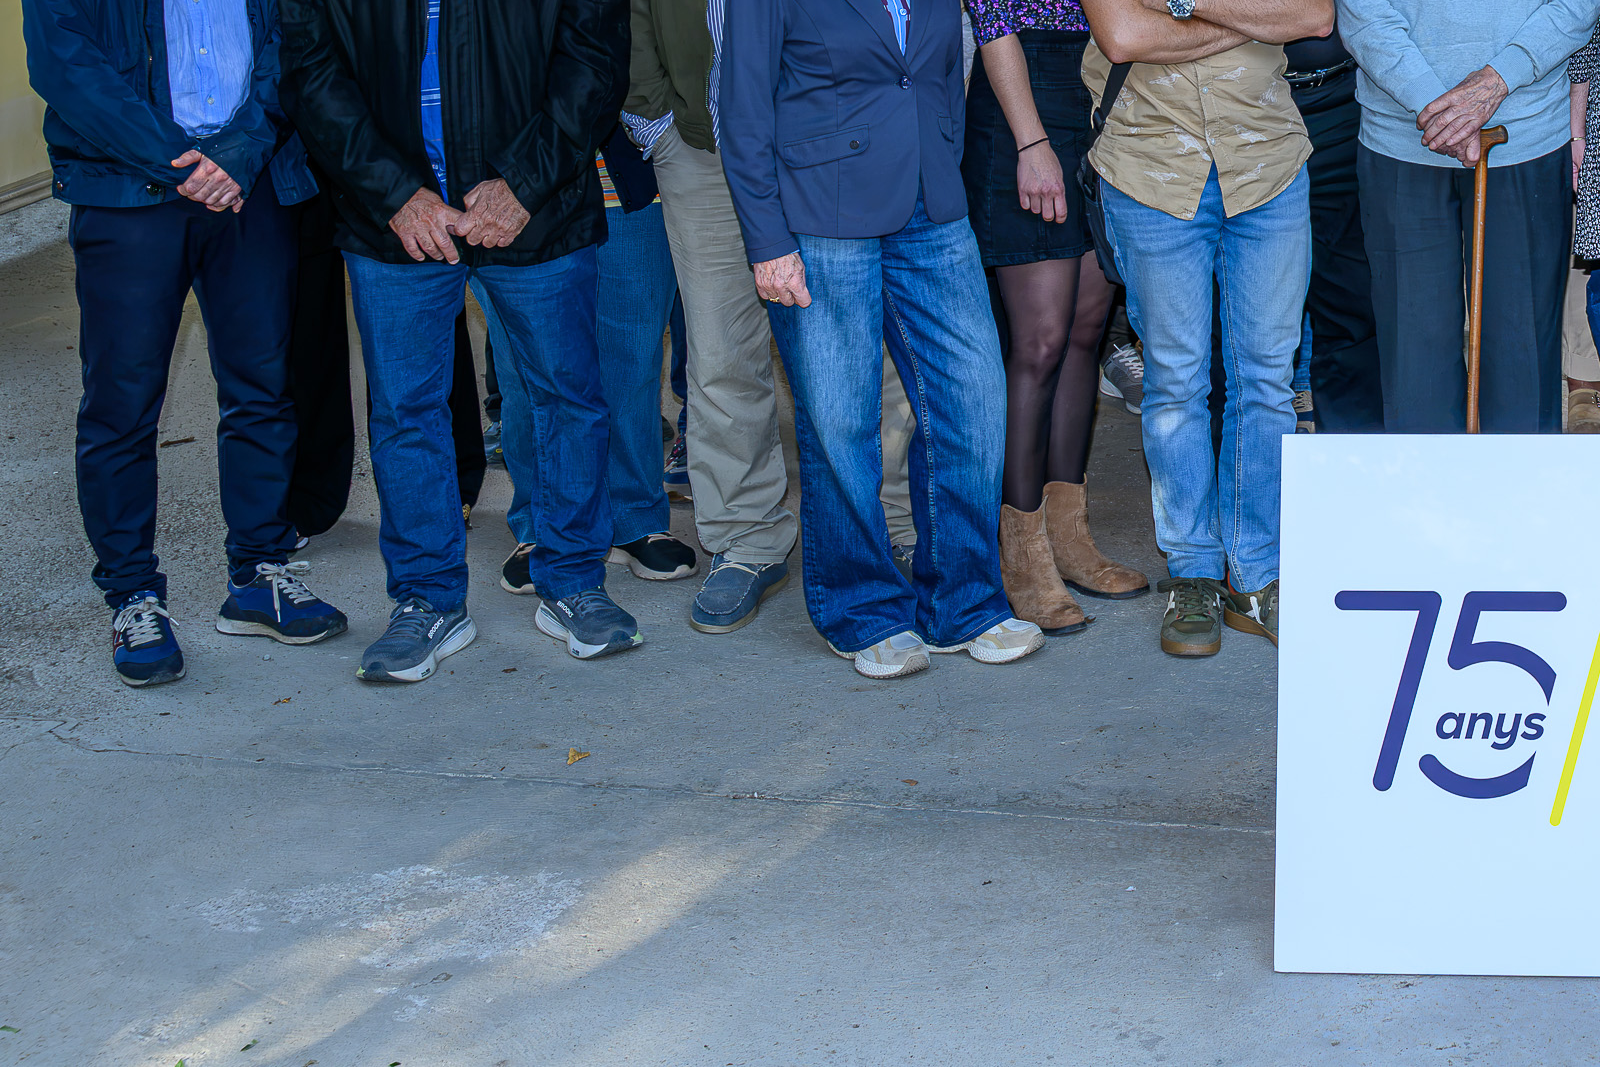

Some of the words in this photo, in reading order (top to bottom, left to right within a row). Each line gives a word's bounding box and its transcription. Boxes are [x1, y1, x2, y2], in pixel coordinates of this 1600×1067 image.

[556, 600, 574, 618] BROOKS
[427, 616, 444, 639] BROOKS
[1334, 590, 1568, 800] 75
[1435, 711, 1547, 751] anys
